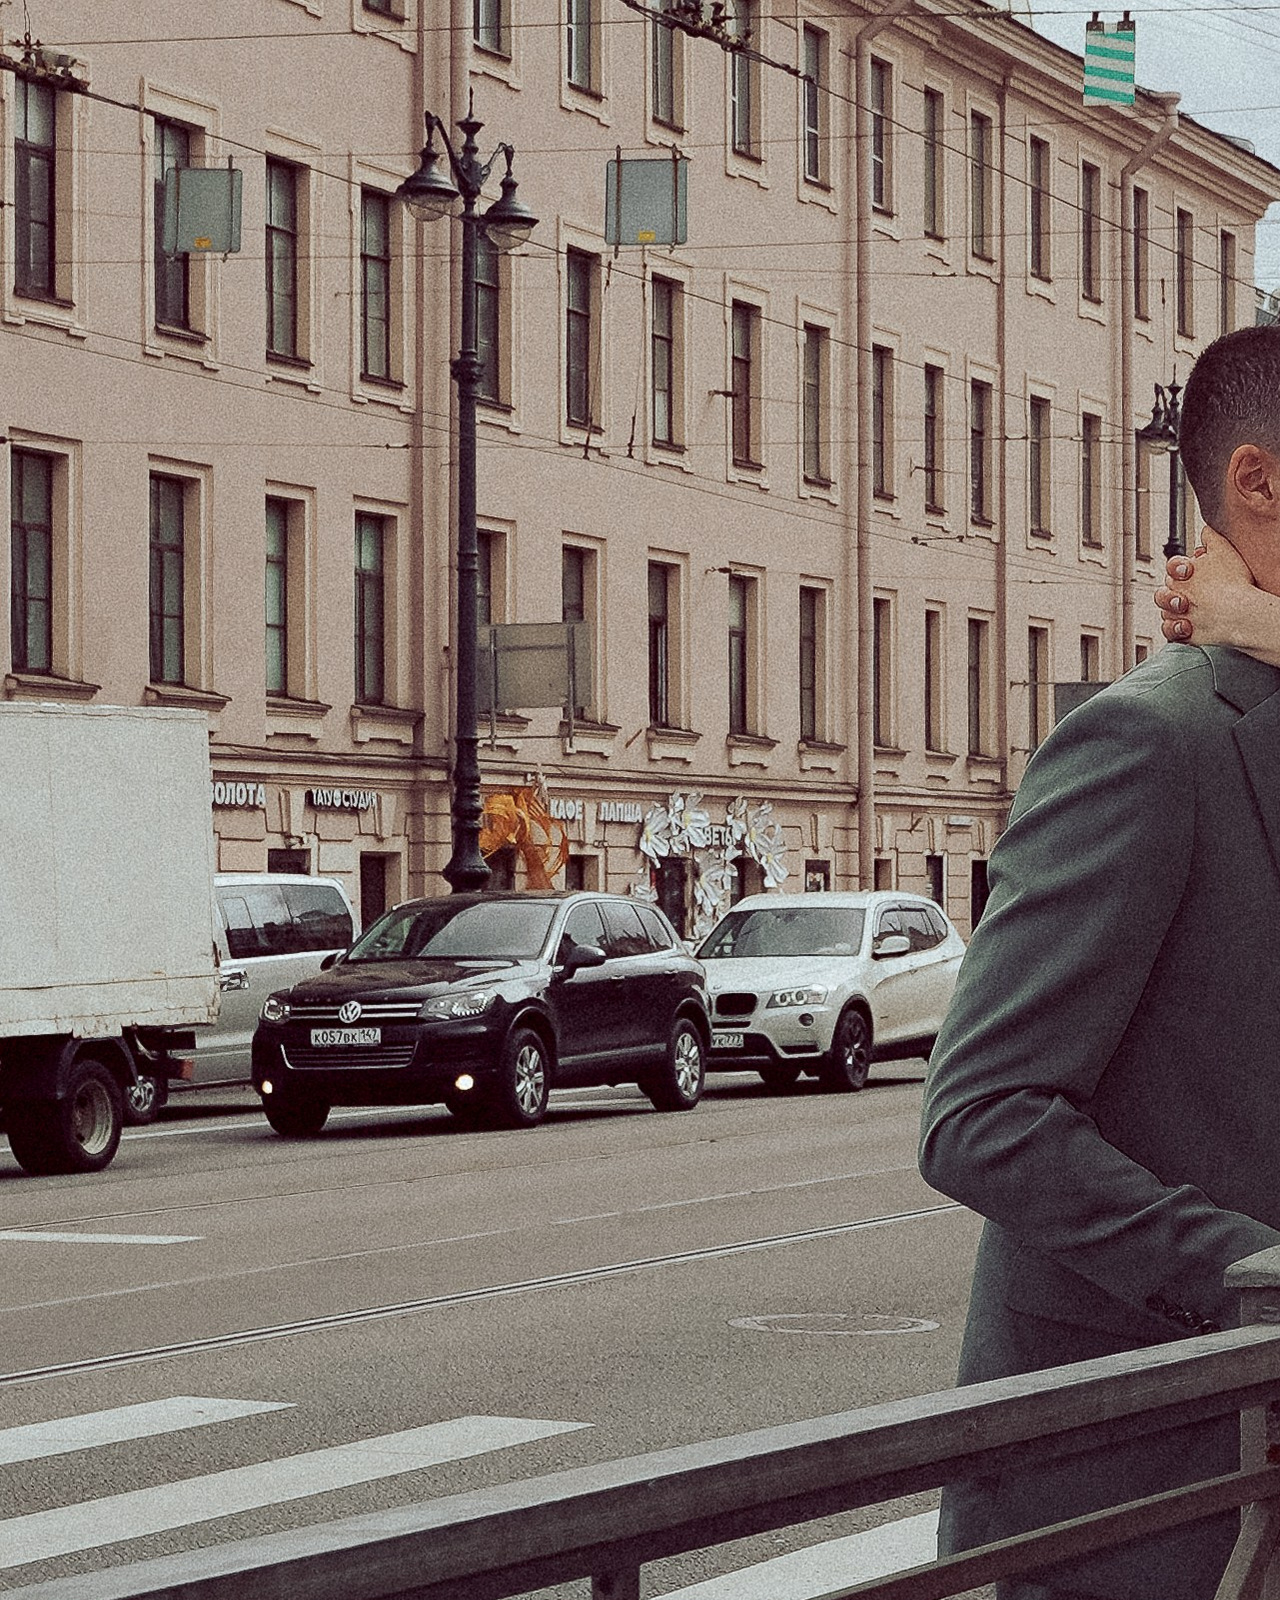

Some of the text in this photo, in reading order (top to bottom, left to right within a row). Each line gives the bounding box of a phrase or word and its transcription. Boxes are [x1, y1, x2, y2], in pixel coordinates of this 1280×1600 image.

[211, 781, 267, 808] ОЛОТА
[550, 798, 583, 820] КАФЕ
[599, 801, 643, 822] ЛАПША
[704, 826, 737, 847] ВЕТЫ
